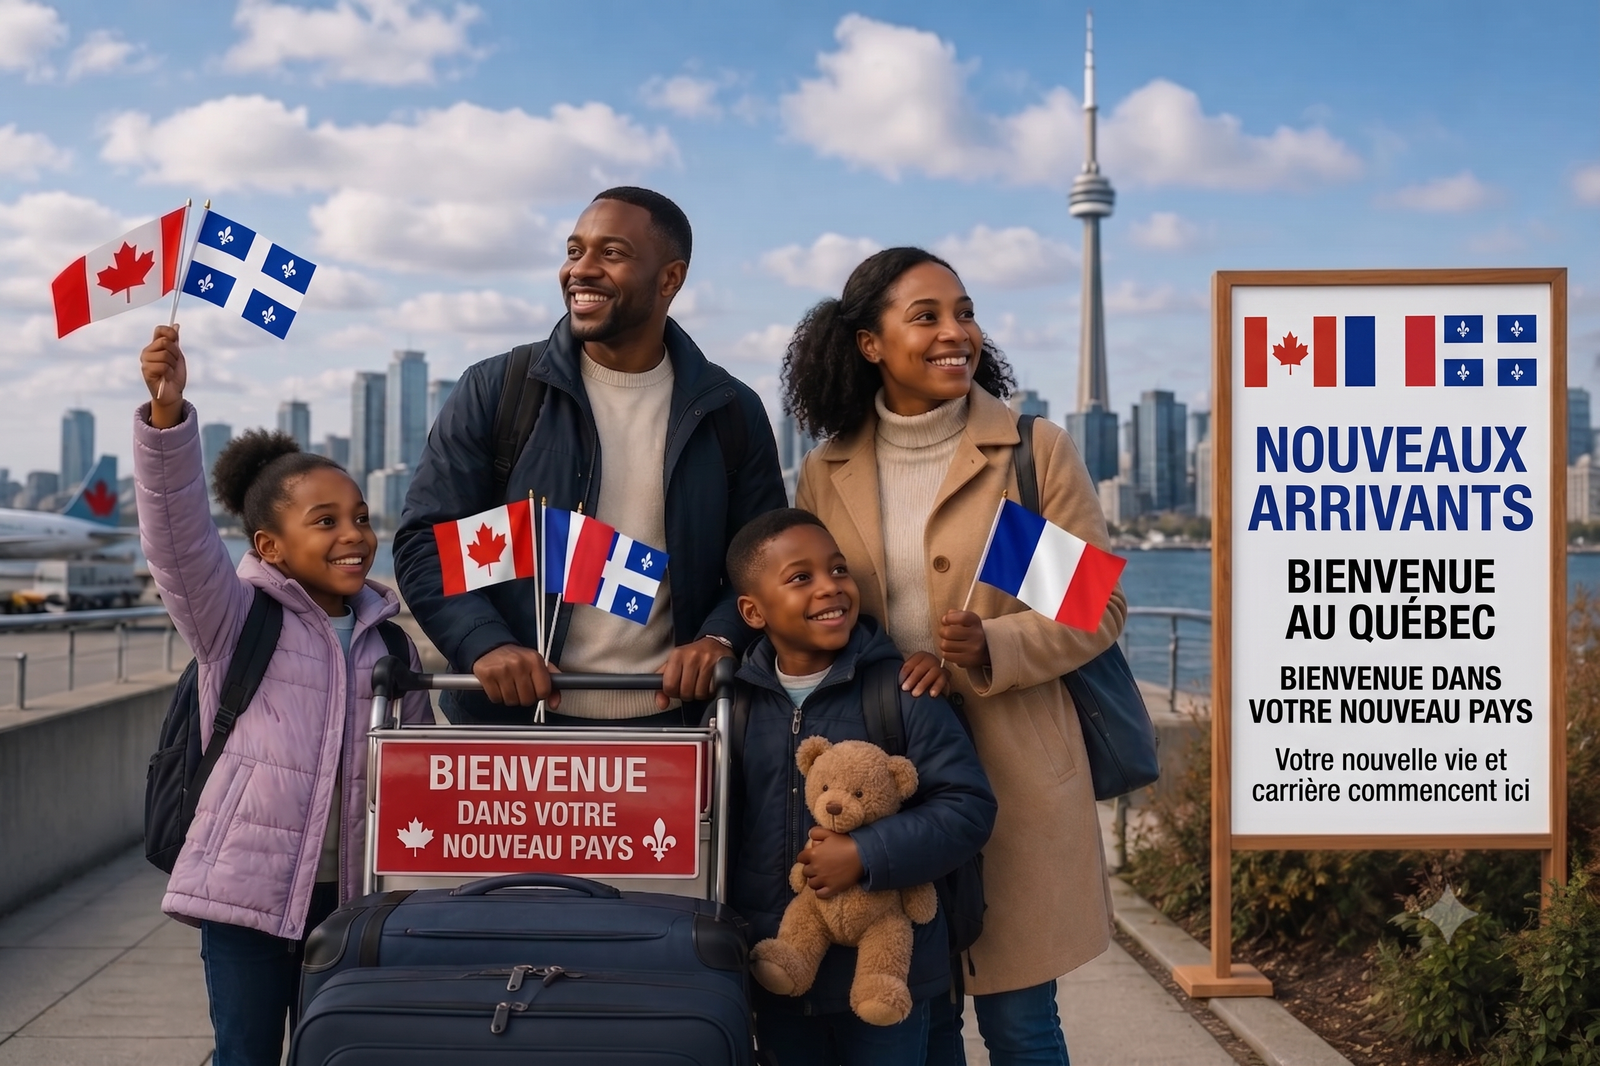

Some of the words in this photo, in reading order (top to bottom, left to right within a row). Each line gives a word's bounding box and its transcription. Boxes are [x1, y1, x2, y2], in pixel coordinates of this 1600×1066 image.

[1257, 426, 1527, 473] NOUVEAUX
[1248, 484, 1533, 531] ARRIVANTS
[1289, 559, 1495, 593] BIENVENUE
[1285, 605, 1335, 640] AU
[1349, 596, 1495, 643] QUÉBEC
[1281, 666, 1423, 690] BIENVENUE
[1433, 666, 1501, 690] DANS
[1249, 699, 1331, 723] VOTRE
[1341, 699, 1460, 723] NOUVEAU
[1470, 699, 1532, 723] PAYS
[1275, 748, 1333, 771] Votre
[1343, 748, 1437, 771] nouvelle
[1445, 748, 1477, 771] vie
[1486, 749, 1507, 771] et
[430, 755, 646, 792] BIENVENUE
[1253, 778, 1340, 801] carrière
[1349, 780, 1497, 801] commencent
[1506, 779, 1529, 801] ici
[459, 801, 526, 825] DANS
[535, 802, 616, 826] VOTRE
[444, 834, 561, 859] NOUVEAU
[571, 836, 633, 860] PAYS
